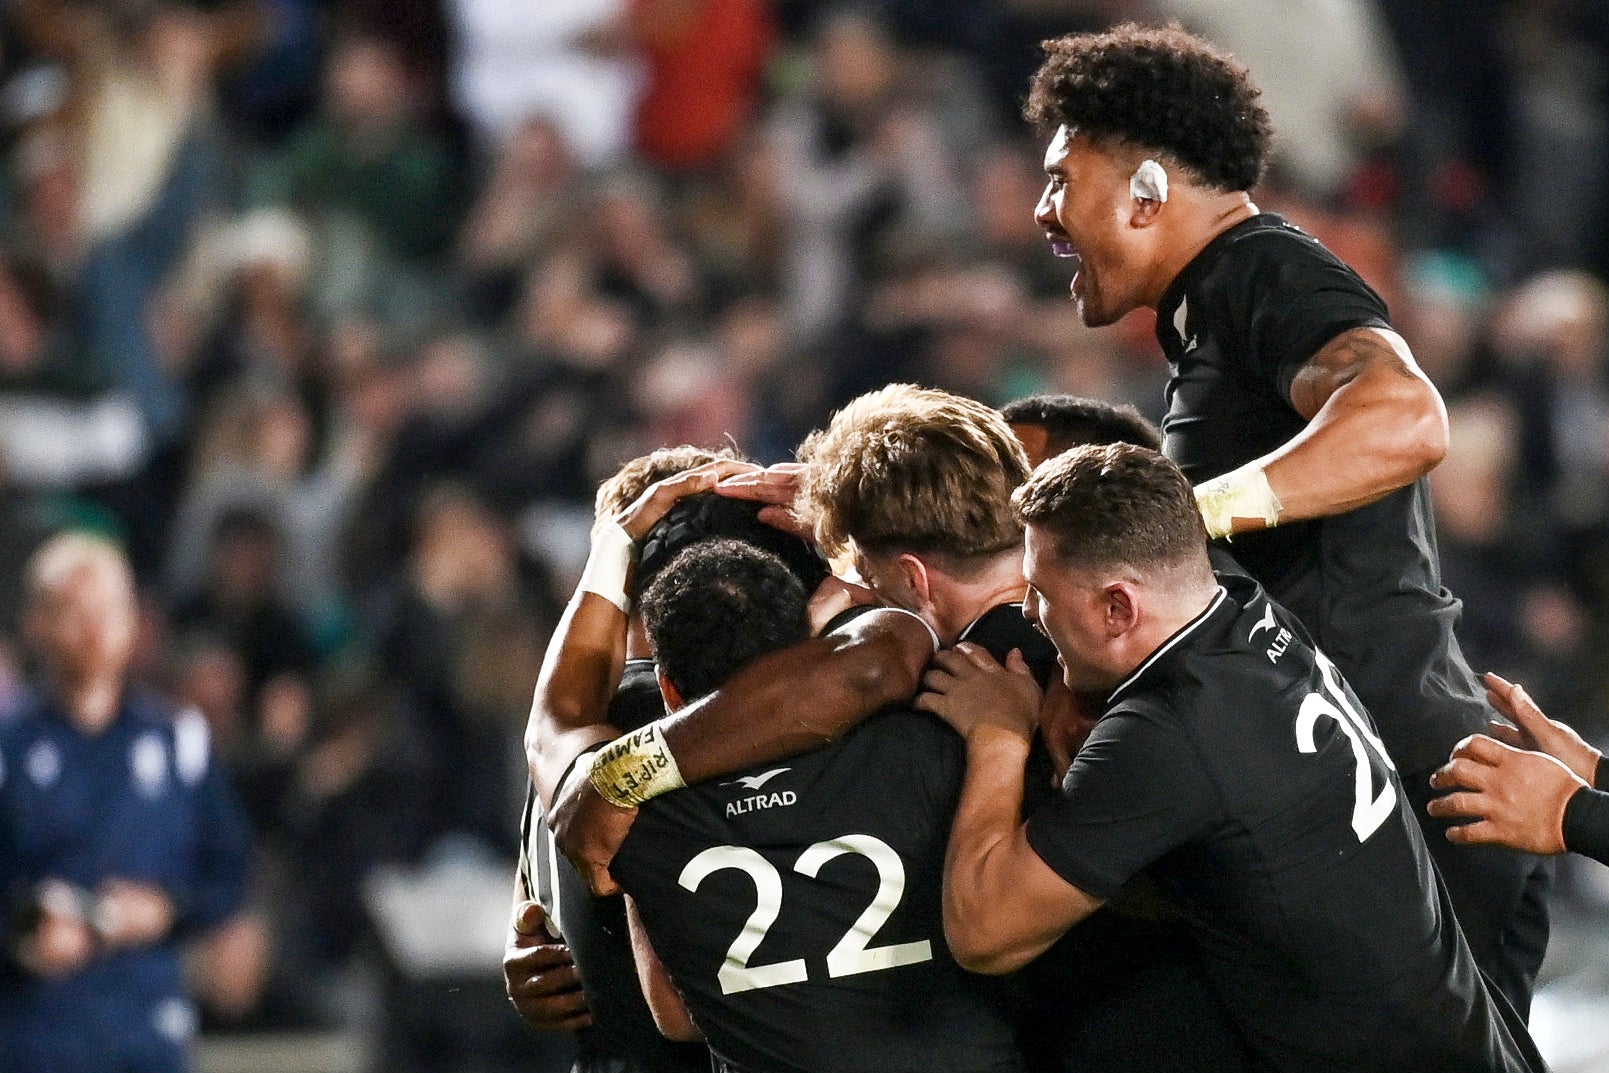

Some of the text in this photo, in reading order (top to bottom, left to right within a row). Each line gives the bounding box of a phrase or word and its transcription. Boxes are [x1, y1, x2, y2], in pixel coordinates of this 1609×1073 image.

[1266, 627, 1292, 664] ALTR
[726, 790, 797, 818] ALTRAD
[678, 834, 932, 995] 22
